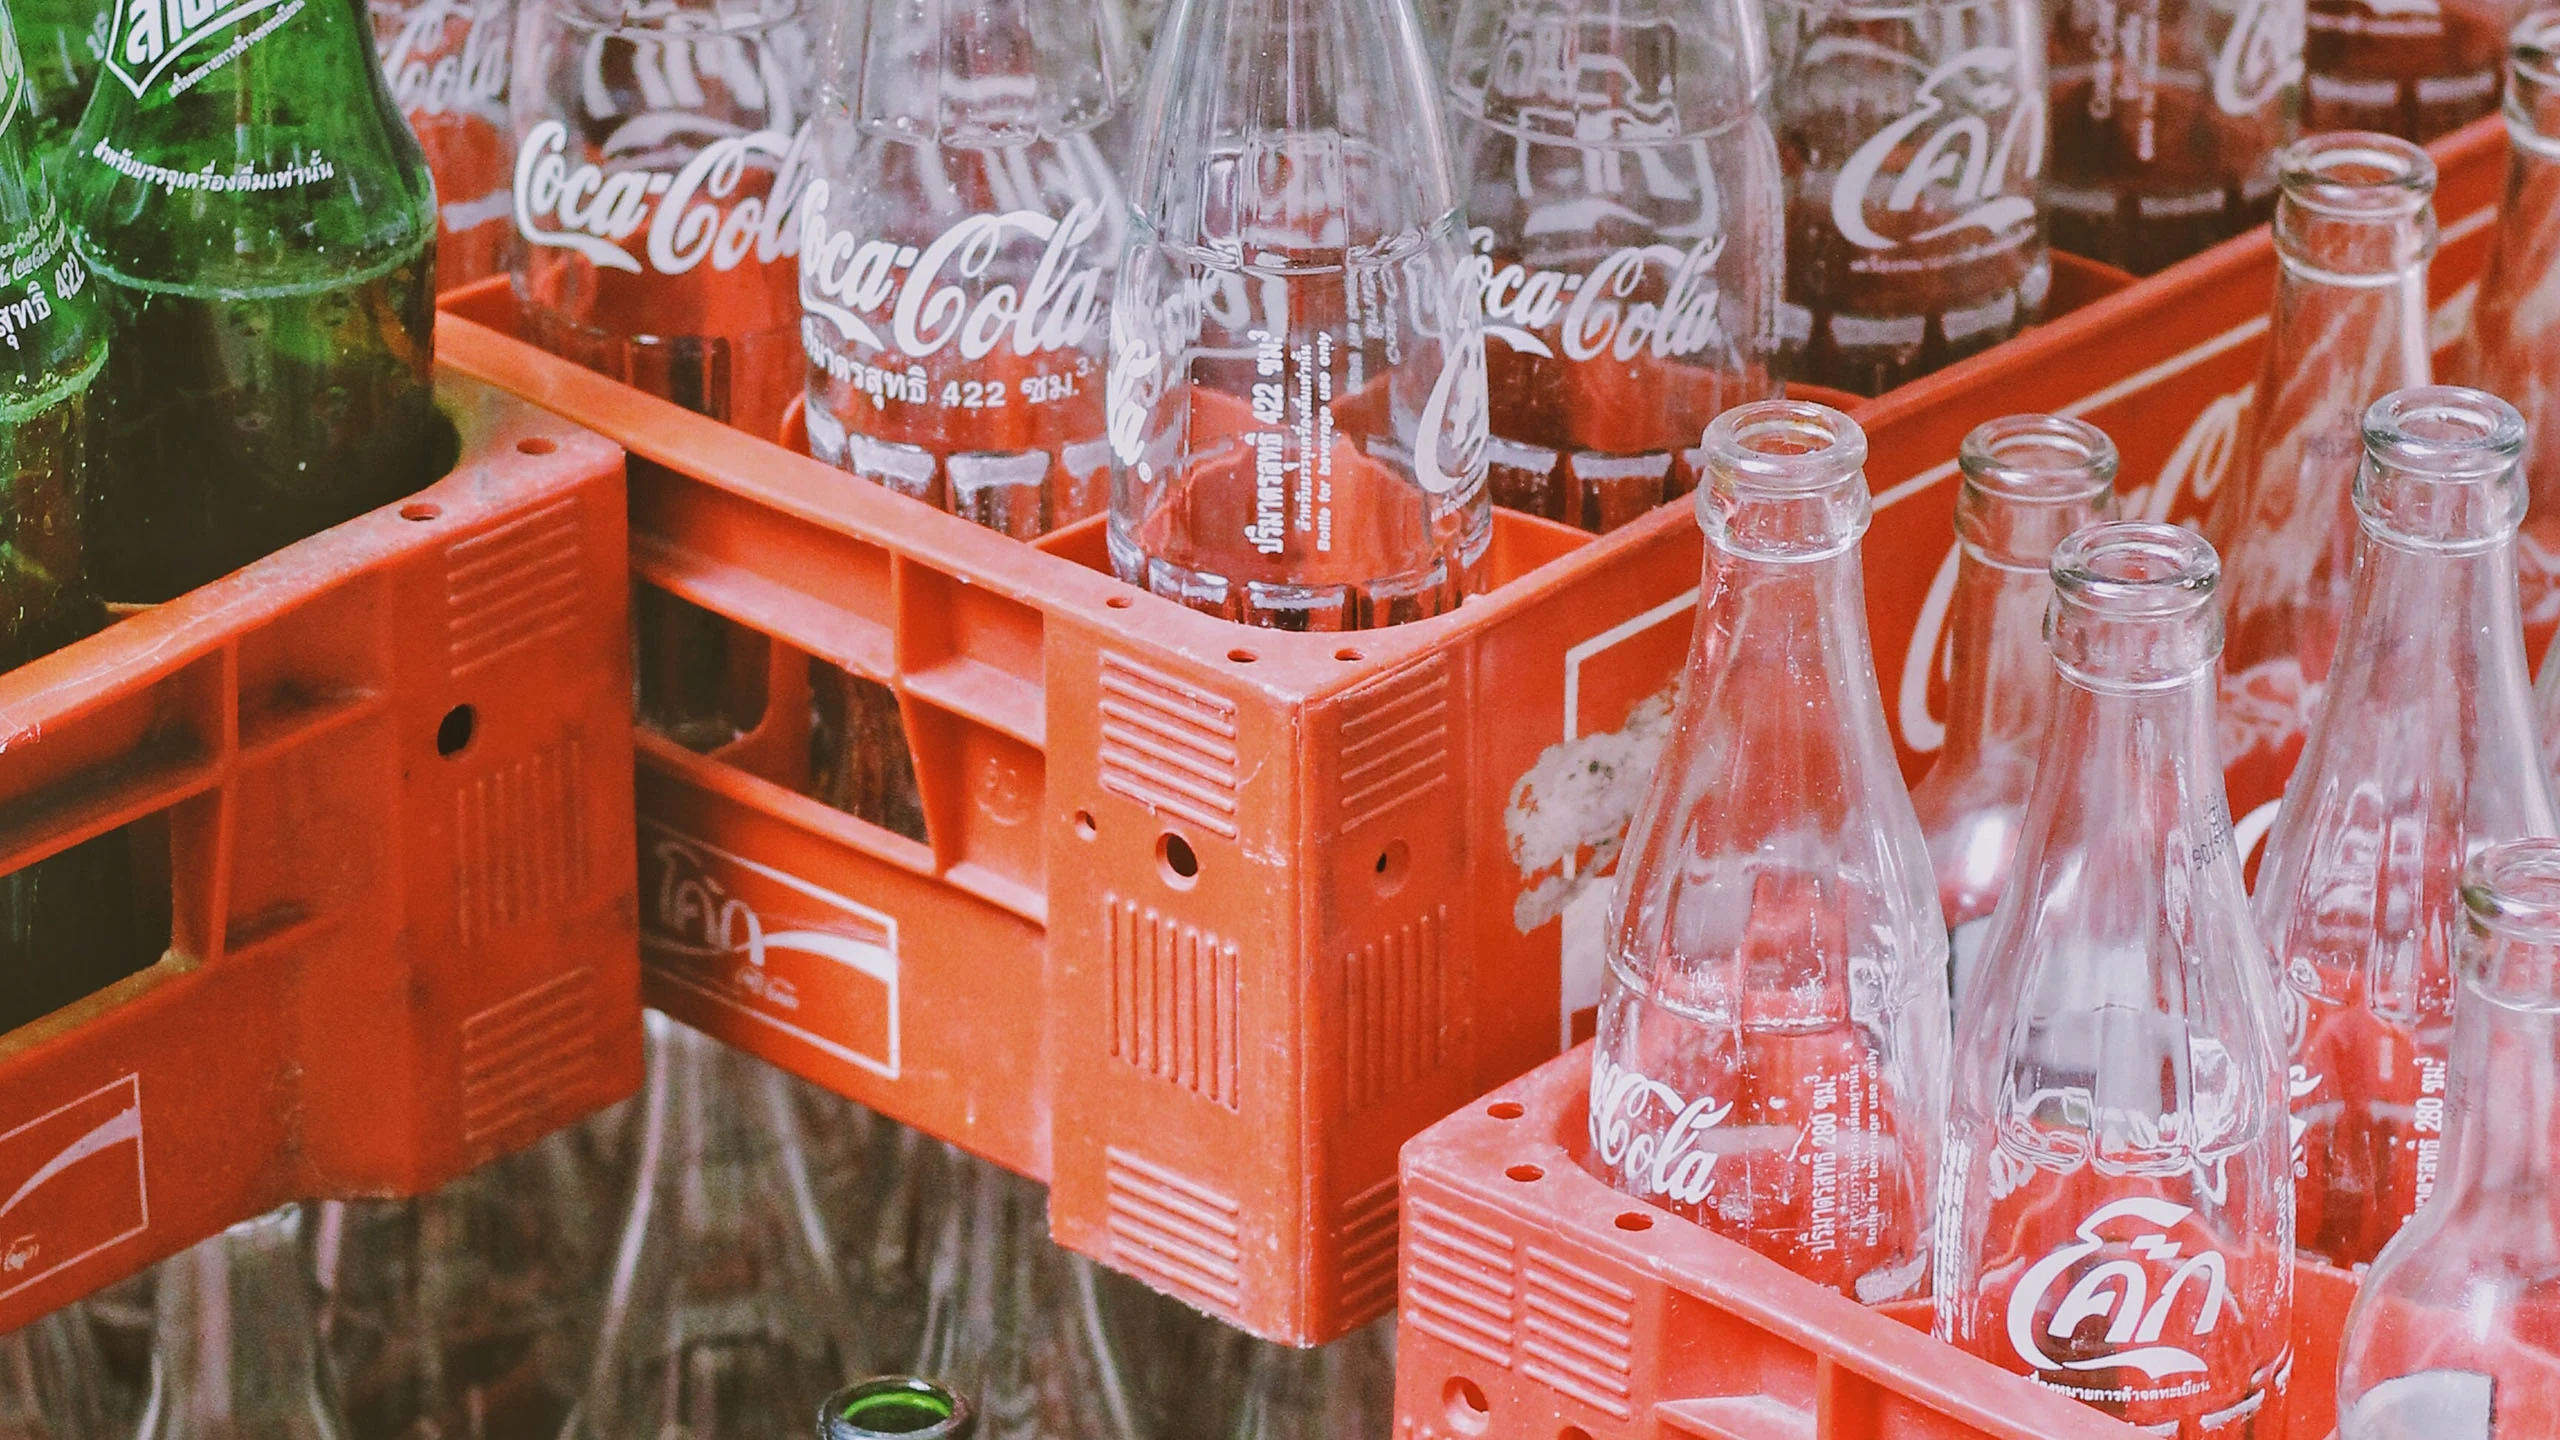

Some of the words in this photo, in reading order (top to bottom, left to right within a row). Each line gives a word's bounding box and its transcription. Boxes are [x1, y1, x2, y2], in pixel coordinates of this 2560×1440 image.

[92, 136, 335, 196] สำหรับบรรจุเครื่องดื่มเท่านั้น
[54, 252, 86, 300] 422
[799, 178, 1107, 361] Coca-Cola
[1316, 331, 1335, 367] only
[940, 379, 1006, 409] 422
[1252, 382, 1285, 425] 422
[1318, 372, 1331, 402] use
[1316, 406, 1334, 477] beverage
[1244, 432, 1300, 555] ปริมาตรสุทธิ
[1316, 481, 1331, 503] for
[1316, 507, 1331, 552] Bottle
[1863, 1047, 1881, 1080] only
[1866, 1084, 1880, 1109] use
[2413, 1097, 2444, 1133] 280
[1810, 1112, 1838, 1147] 280
[1865, 1114, 1881, 1179] beverage
[1865, 1182, 1880, 1202] for
[1865, 1205, 1880, 1247] Bottle
